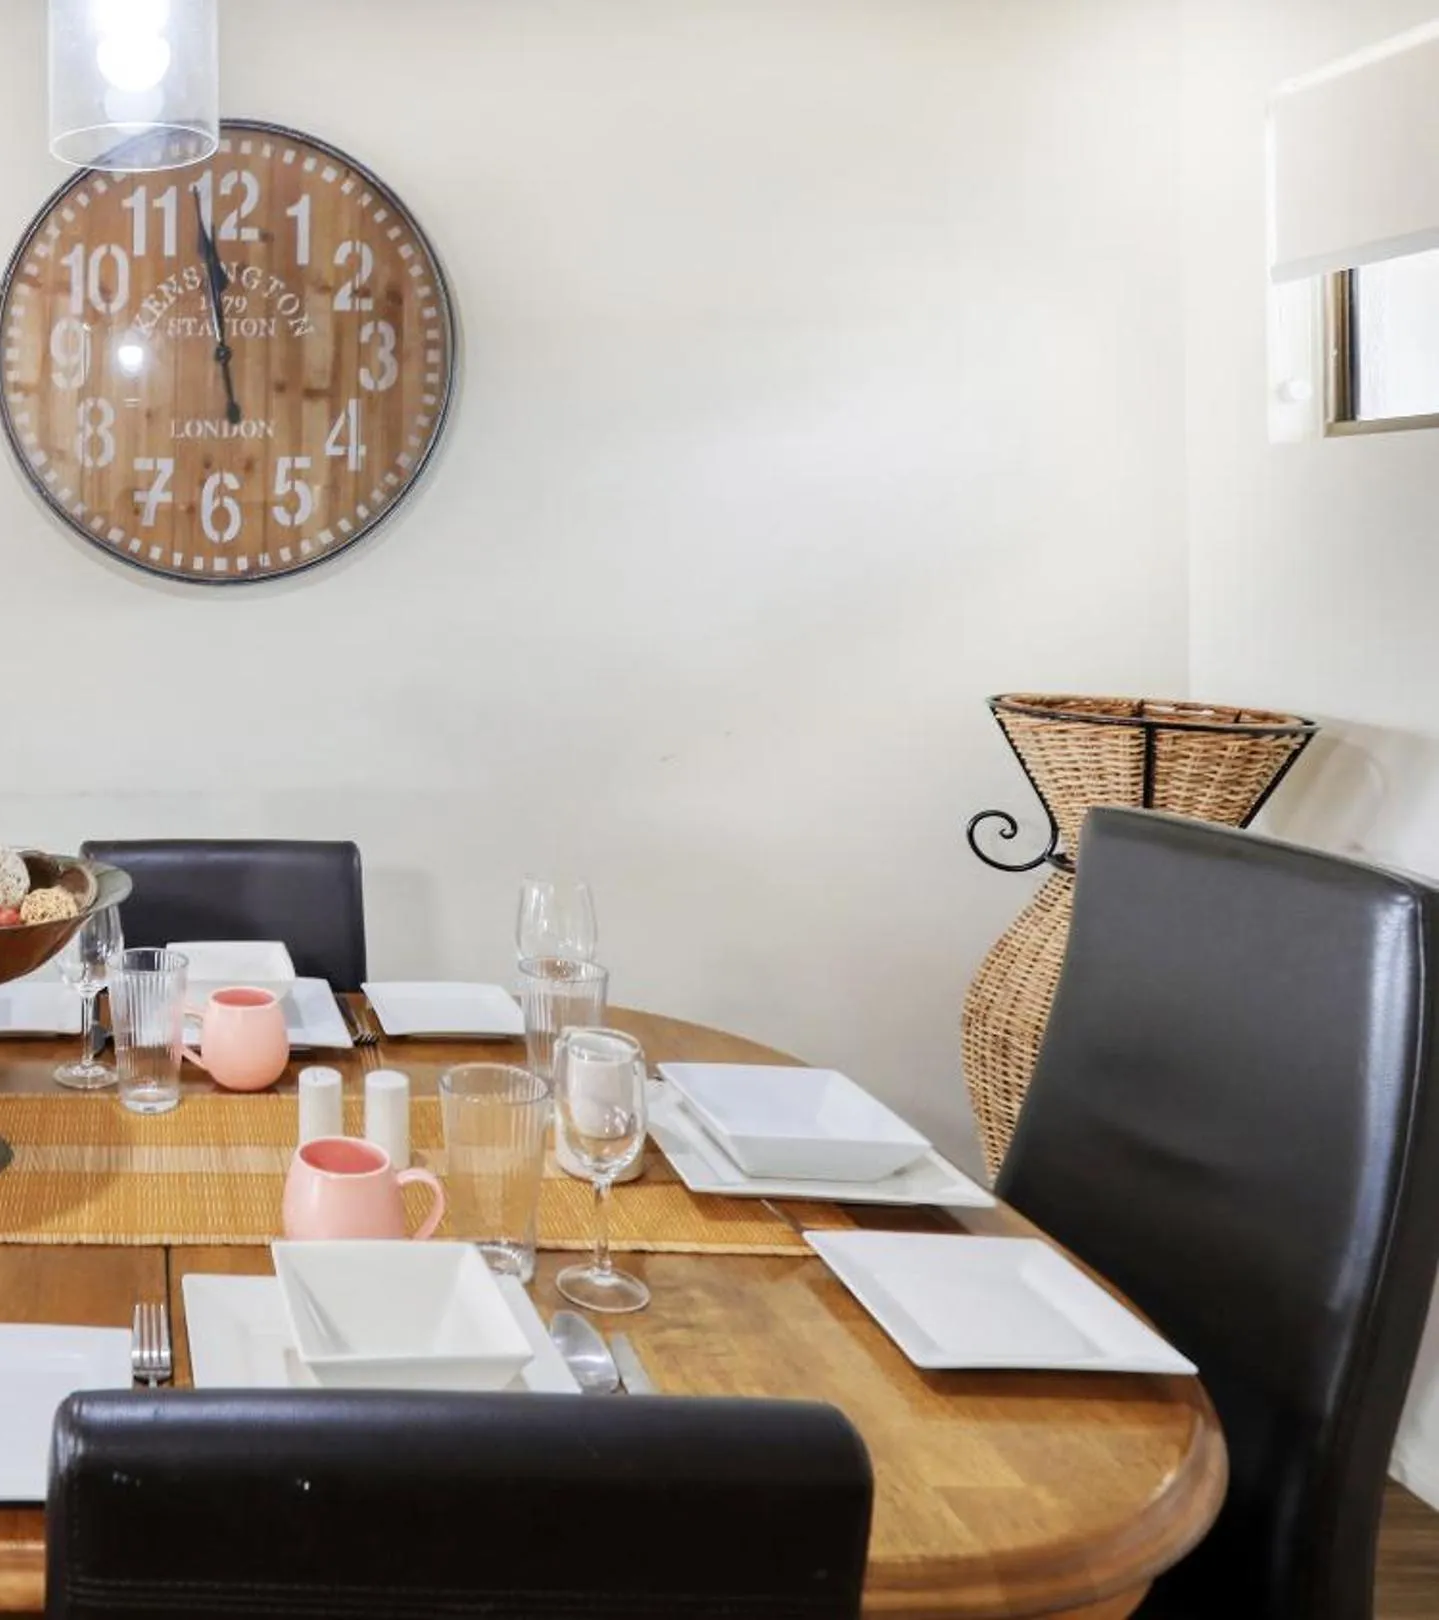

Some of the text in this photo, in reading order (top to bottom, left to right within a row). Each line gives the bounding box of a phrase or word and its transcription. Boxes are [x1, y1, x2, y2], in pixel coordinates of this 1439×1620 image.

[123, 185, 178, 256] 11
[188, 170, 259, 240] 12
[287, 194, 310, 265] 1
[61, 243, 129, 316] 10
[200, 296, 247, 314] 179
[333, 240, 375, 312] 2
[50, 317, 91, 390] 9
[167, 318, 277, 337] STAION
[359, 320, 398, 392] 3
[75, 397, 115, 469] 8
[170, 420, 275, 438] LONDON
[325, 399, 366, 471] 4
[133, 458, 174, 526] 7
[201, 473, 242, 543] 6
[272, 457, 312, 527] 5
